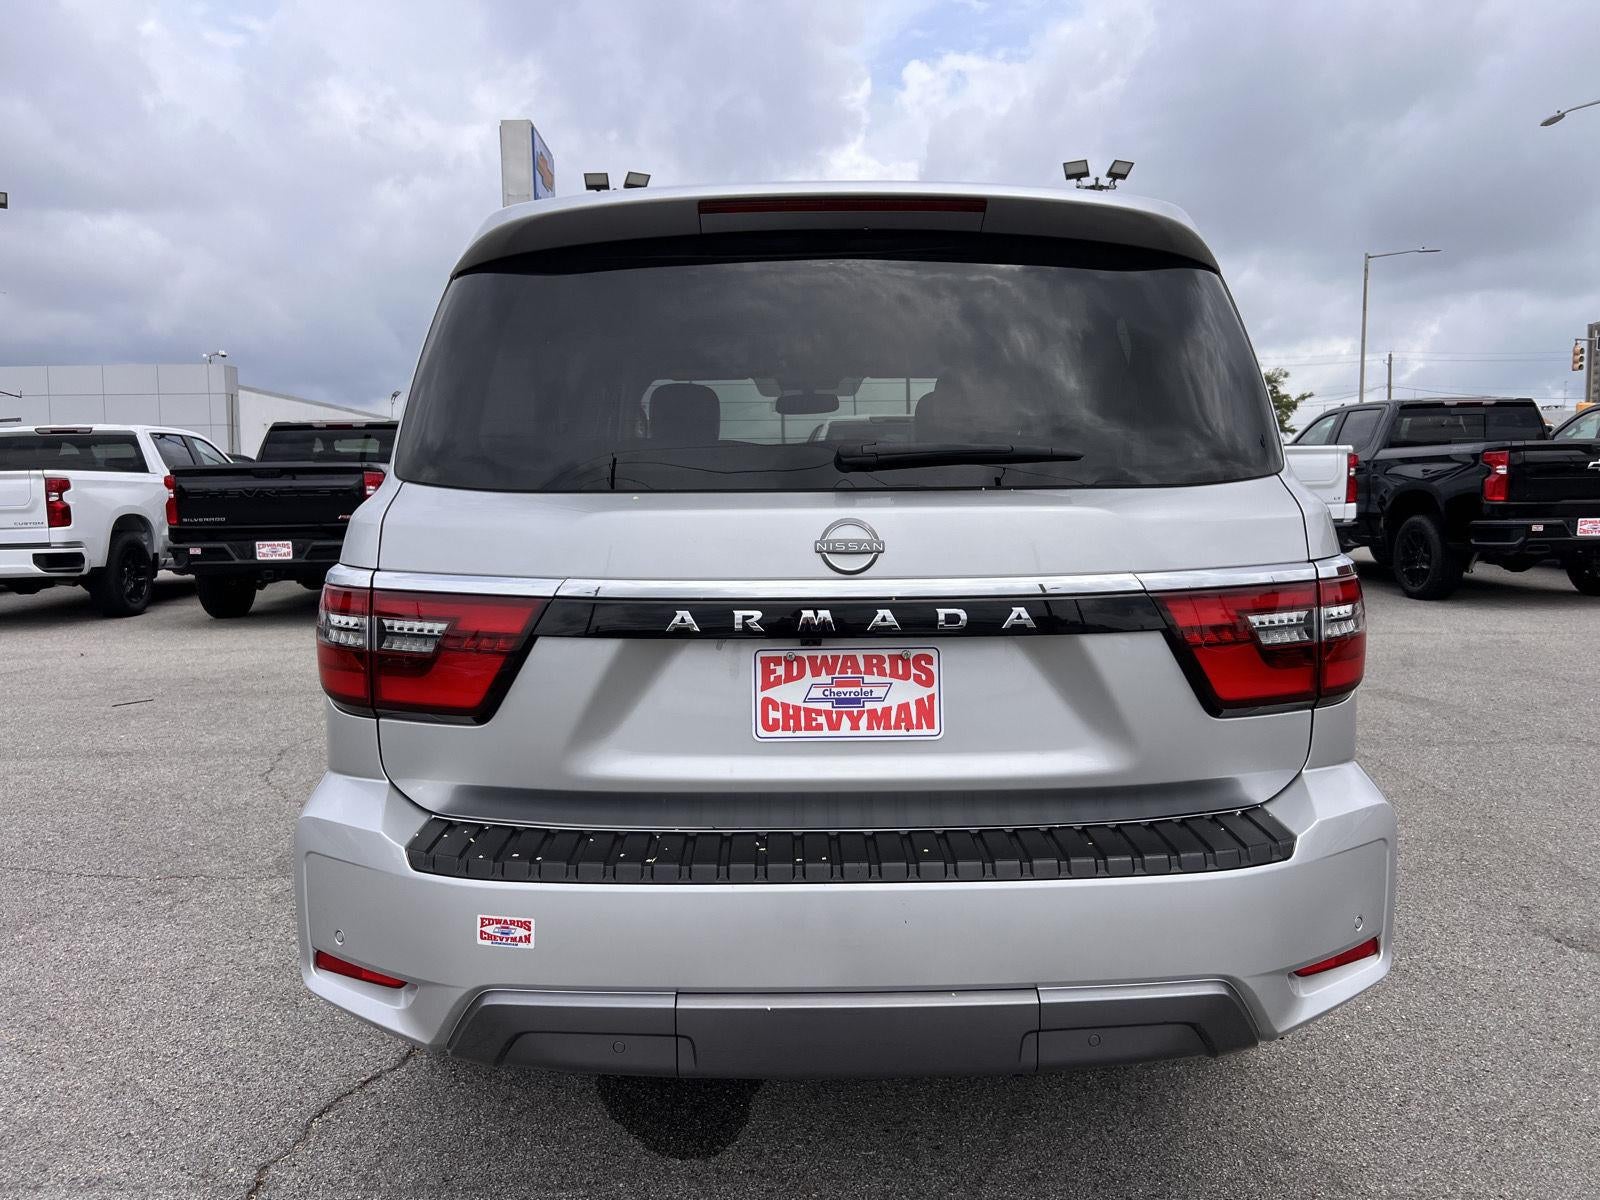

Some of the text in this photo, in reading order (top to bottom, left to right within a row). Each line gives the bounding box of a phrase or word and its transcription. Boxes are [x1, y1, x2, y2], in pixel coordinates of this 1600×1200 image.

[816, 542, 883, 551] NISSAN
[665, 609, 1037, 632] ARMADA
[760, 653, 935, 692] EDWARDS
[822, 688, 874, 698] Chevrolet
[760, 692, 936, 732] CHEVYMAN
[480, 917, 531, 932] EDWARDS
[480, 930, 531, 943] CHEVYMAN
